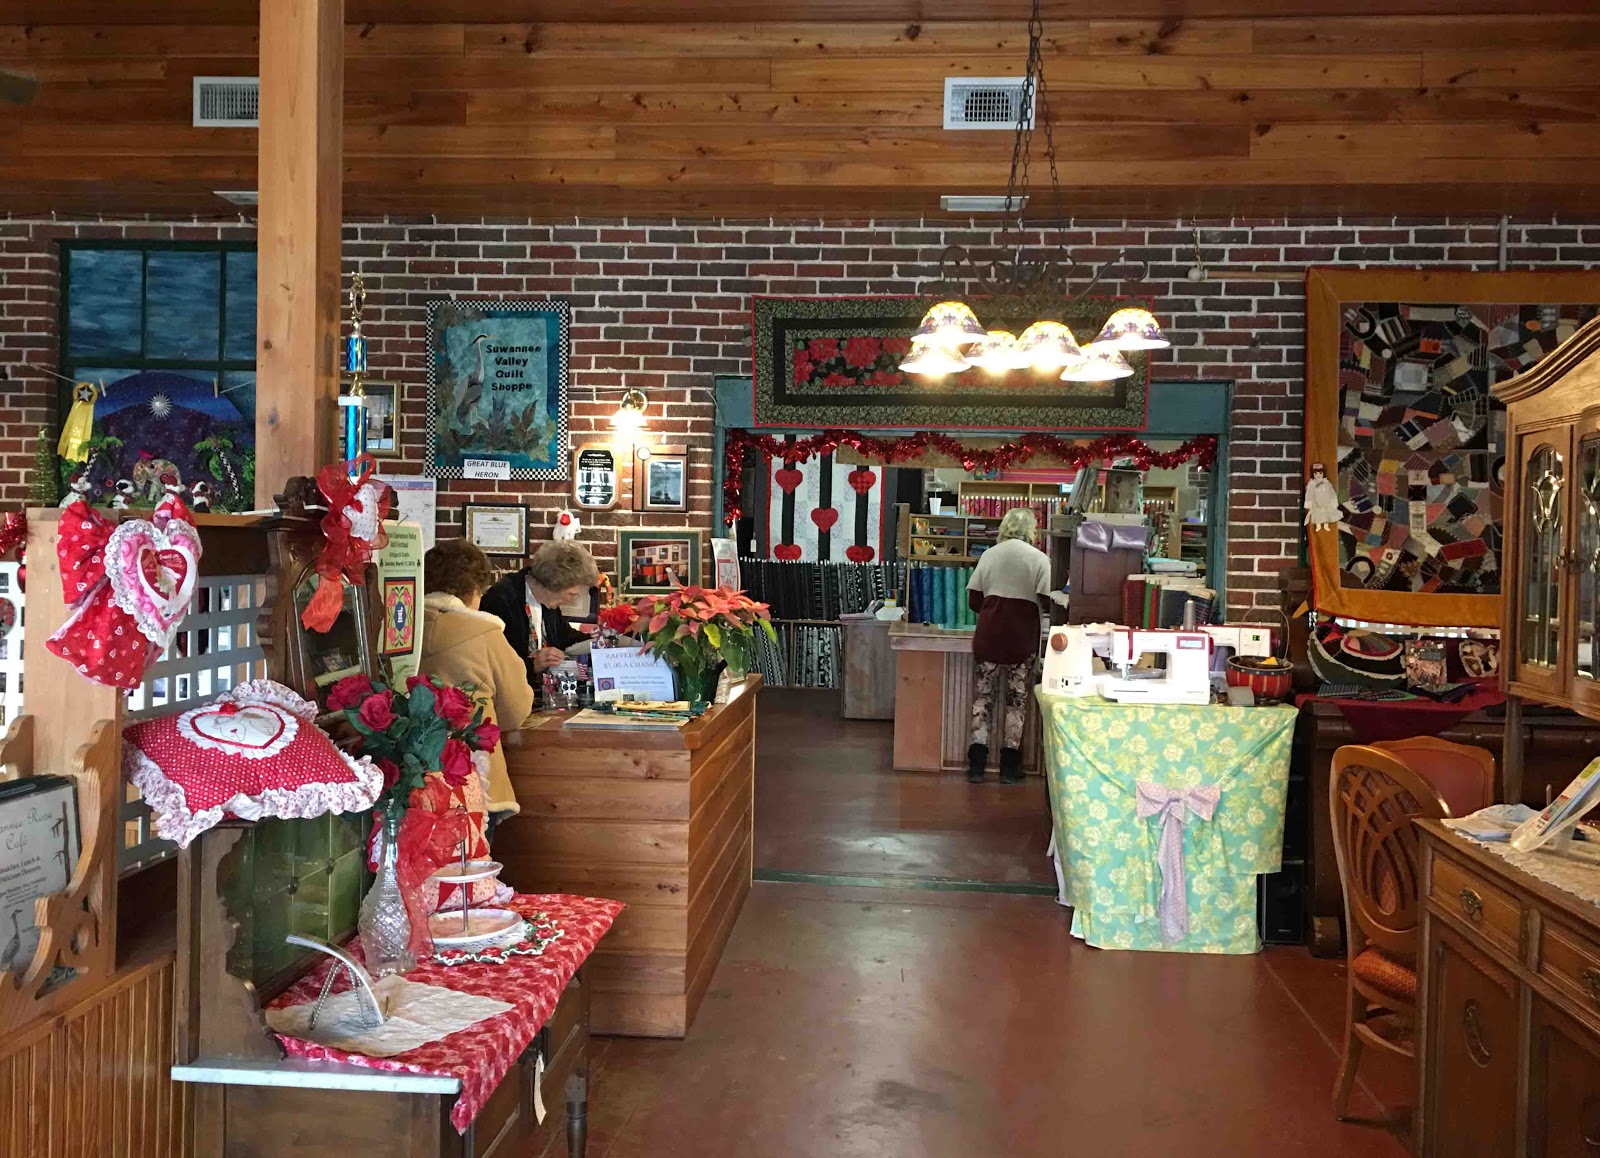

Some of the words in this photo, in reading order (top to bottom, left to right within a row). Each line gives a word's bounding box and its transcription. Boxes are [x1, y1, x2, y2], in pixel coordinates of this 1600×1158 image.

[486, 344, 542, 354] Suwannee
[495, 356, 529, 367] Valley
[495, 370, 524, 379] Quilt
[491, 382, 533, 392] Shoppe
[466, 460, 489, 468] GREAT
[490, 461, 508, 469] BLUE
[605, 652, 633, 660] RAFFLE
[6, 831, 28, 854] Café
